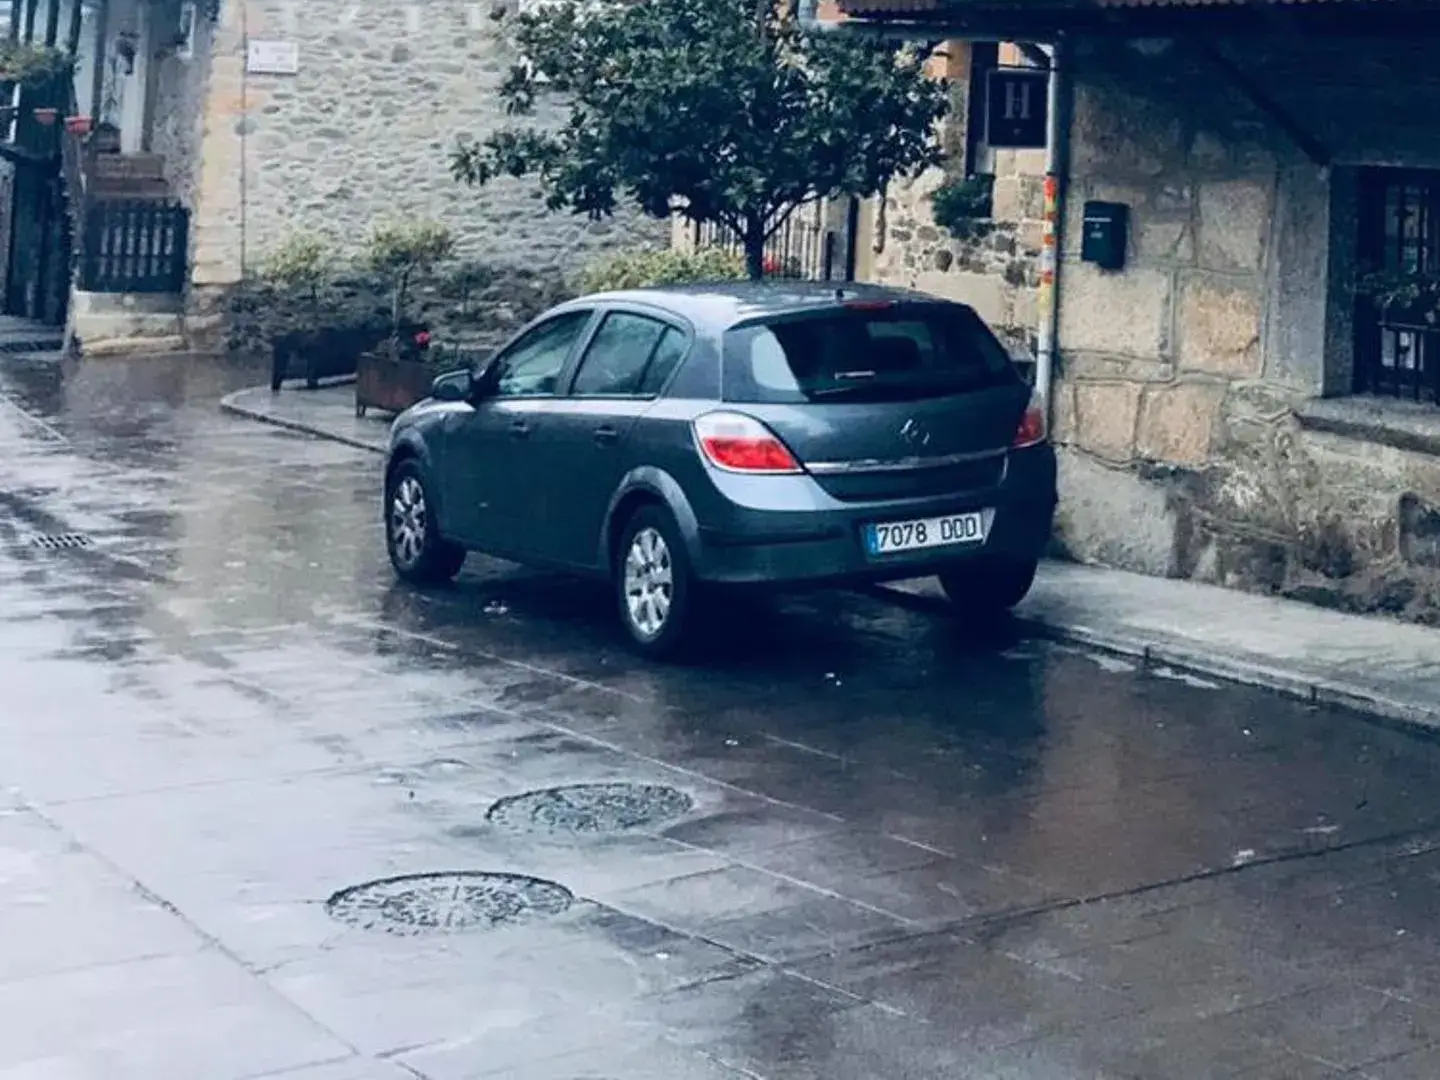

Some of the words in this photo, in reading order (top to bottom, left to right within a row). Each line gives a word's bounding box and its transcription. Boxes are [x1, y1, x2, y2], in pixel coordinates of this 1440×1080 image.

[1002, 81, 1032, 120] H
[878, 522, 927, 549] 7078
[940, 516, 977, 541] DDD
